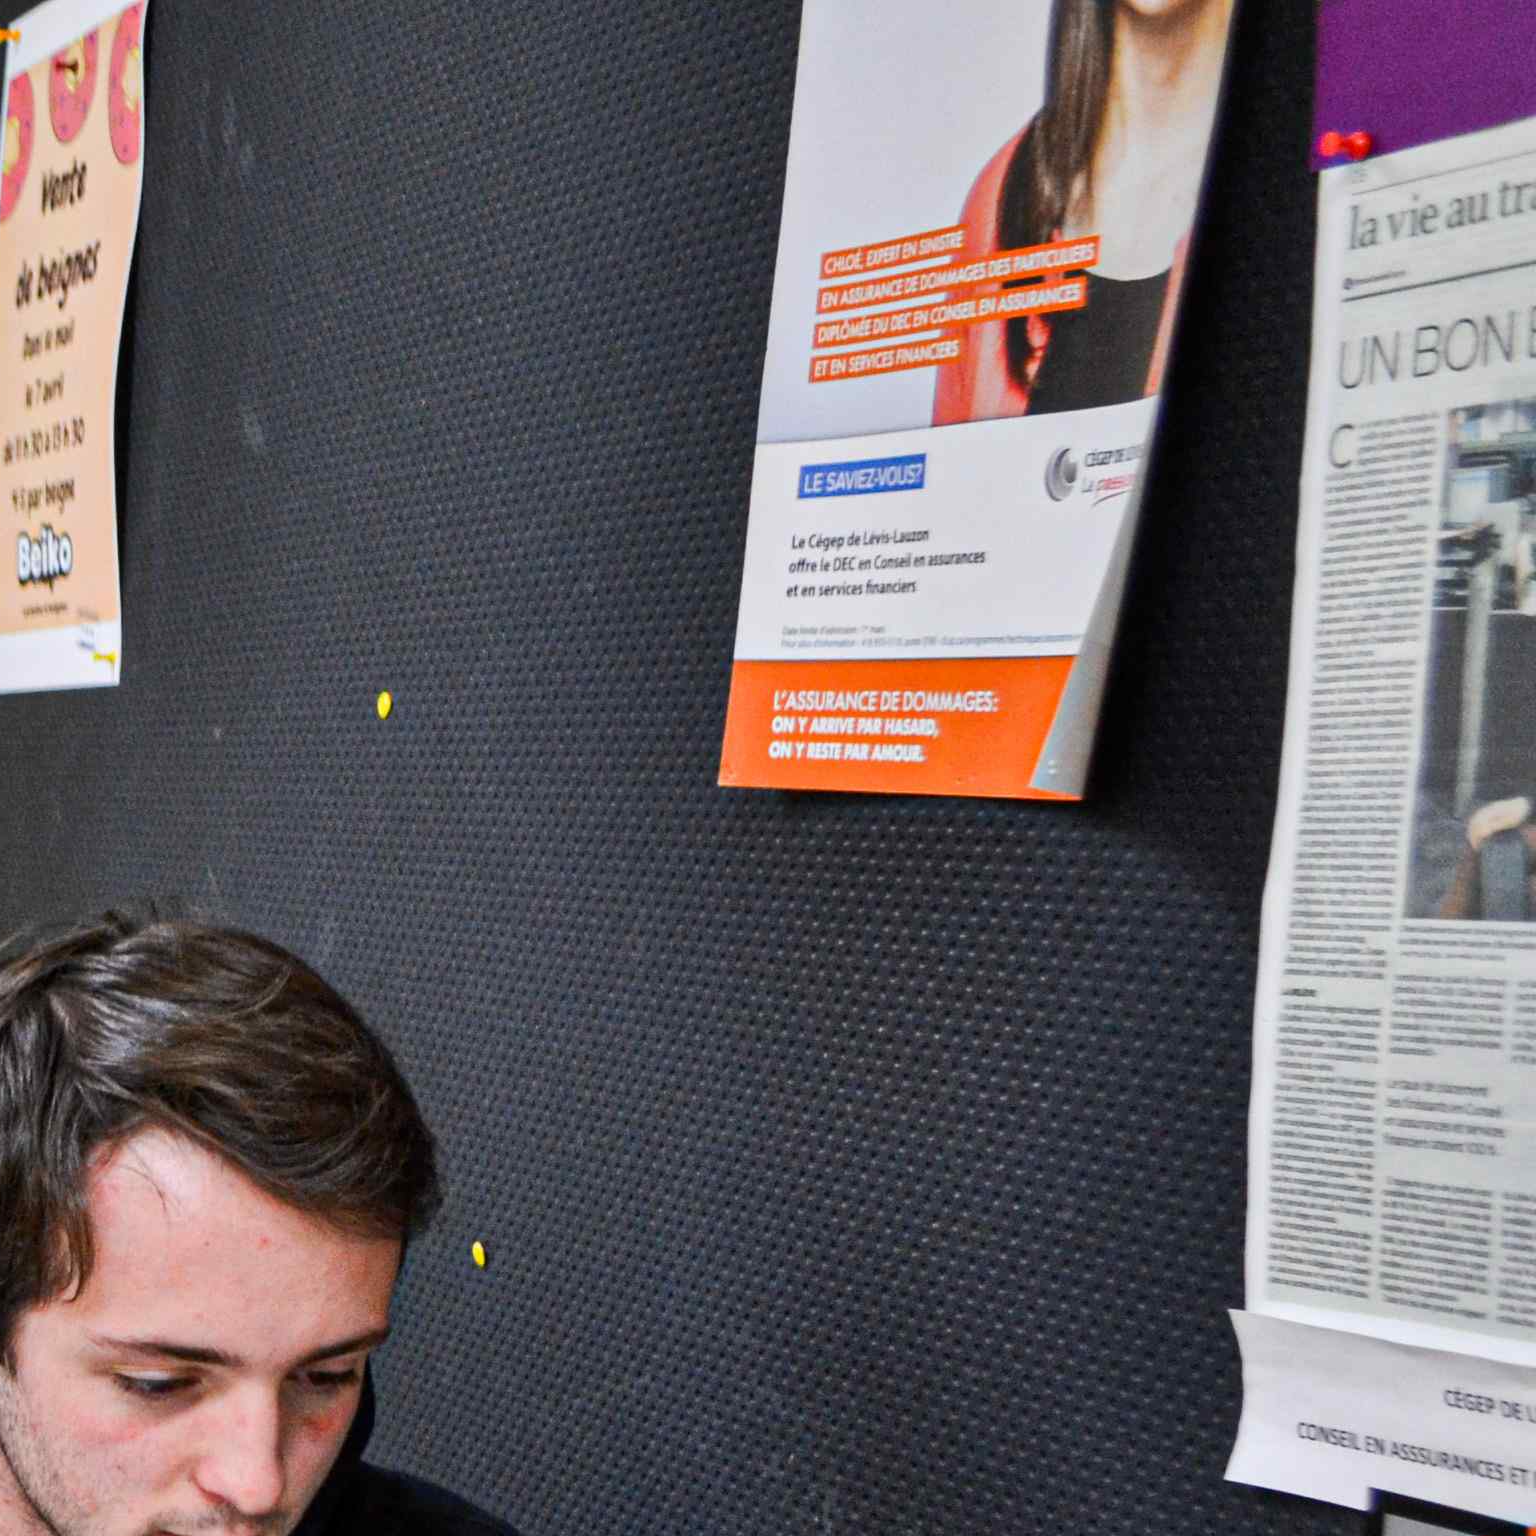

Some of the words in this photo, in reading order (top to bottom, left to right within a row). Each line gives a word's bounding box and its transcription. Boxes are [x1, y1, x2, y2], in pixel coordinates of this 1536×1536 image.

[41, 157, 87, 215] Vente
[1347, 204, 1378, 250] la
[1387, 193, 1437, 240] vie
[1445, 191, 1489, 230] au
[866, 244, 900, 266] EXPERT
[902, 242, 916, 260] EN
[918, 230, 964, 256] SINISTRE
[15, 259, 33, 309] de
[37, 240, 100, 311] beignes
[820, 290, 839, 309] EN
[840, 276, 904, 306] ASSURANCE
[905, 273, 919, 294] DE
[920, 261, 986, 291] DOMMAGES
[988, 256, 1011, 278] DES
[1013, 241, 1096, 274] PARTICULIERS
[873, 315, 888, 334] DU
[890, 310, 912, 332] DEC
[913, 308, 929, 328] EN
[930, 299, 976, 324] CONSEIL
[978, 296, 996, 317] EN
[998, 282, 1082, 312] ASSURANCES
[815, 358, 829, 377] ET
[831, 355, 846, 374] EN
[848, 347, 895, 372] SERVICES
[896, 338, 960, 364] FINANCIERS
[1339, 330, 1400, 389] UN
[1413, 310, 1515, 378] BON
[1330, 422, 1355, 469] C
[803, 472, 824, 494] LE
[827, 460, 924, 491] SAVIEZ-VOUS?
[17, 521, 73, 586] Beiko
[791, 535, 806, 550] Le
[808, 530, 844, 553] Cégep
[846, 530, 861, 547] de
[863, 527, 929, 547] Lévis-Lauzon
[788, 557, 817, 575] offre
[819, 556, 831, 572] le
[832, 554, 856, 572] DEC
[858, 558, 872, 571] en
[874, 551, 912, 570] Conseil
[914, 555, 926, 568] en
[928, 550, 986, 567] assurances
[786, 584, 799, 599] et
[801, 586, 816, 598] en
[818, 580, 863, 597] services
[865, 578, 917, 595] financiers
[774, 690, 877, 712] L'ASSURANCE
[879, 690, 902, 712] DE
[903, 690, 999, 713] DOMMAGES:
[771, 716, 795, 734] ON
[797, 717, 809, 734] Y
[810, 717, 854, 735] ARRIVE
[858, 718, 882, 736] PAR
[884, 718, 940, 737] HASARD,
[768, 742, 793, 759] ON
[795, 742, 805, 759] Y
[806, 743, 842, 760] RESTE
[844, 743, 868, 760] PAR
[871, 744, 926, 763] AMOUR.
[1443, 1386, 1495, 1415] CÉGEP
[1500, 1399, 1523, 1422] DE
[1297, 1420, 1361, 1451] CONSEIL
[1364, 1435, 1386, 1455] EN
[1510, 1467, 1528, 1487] ET
